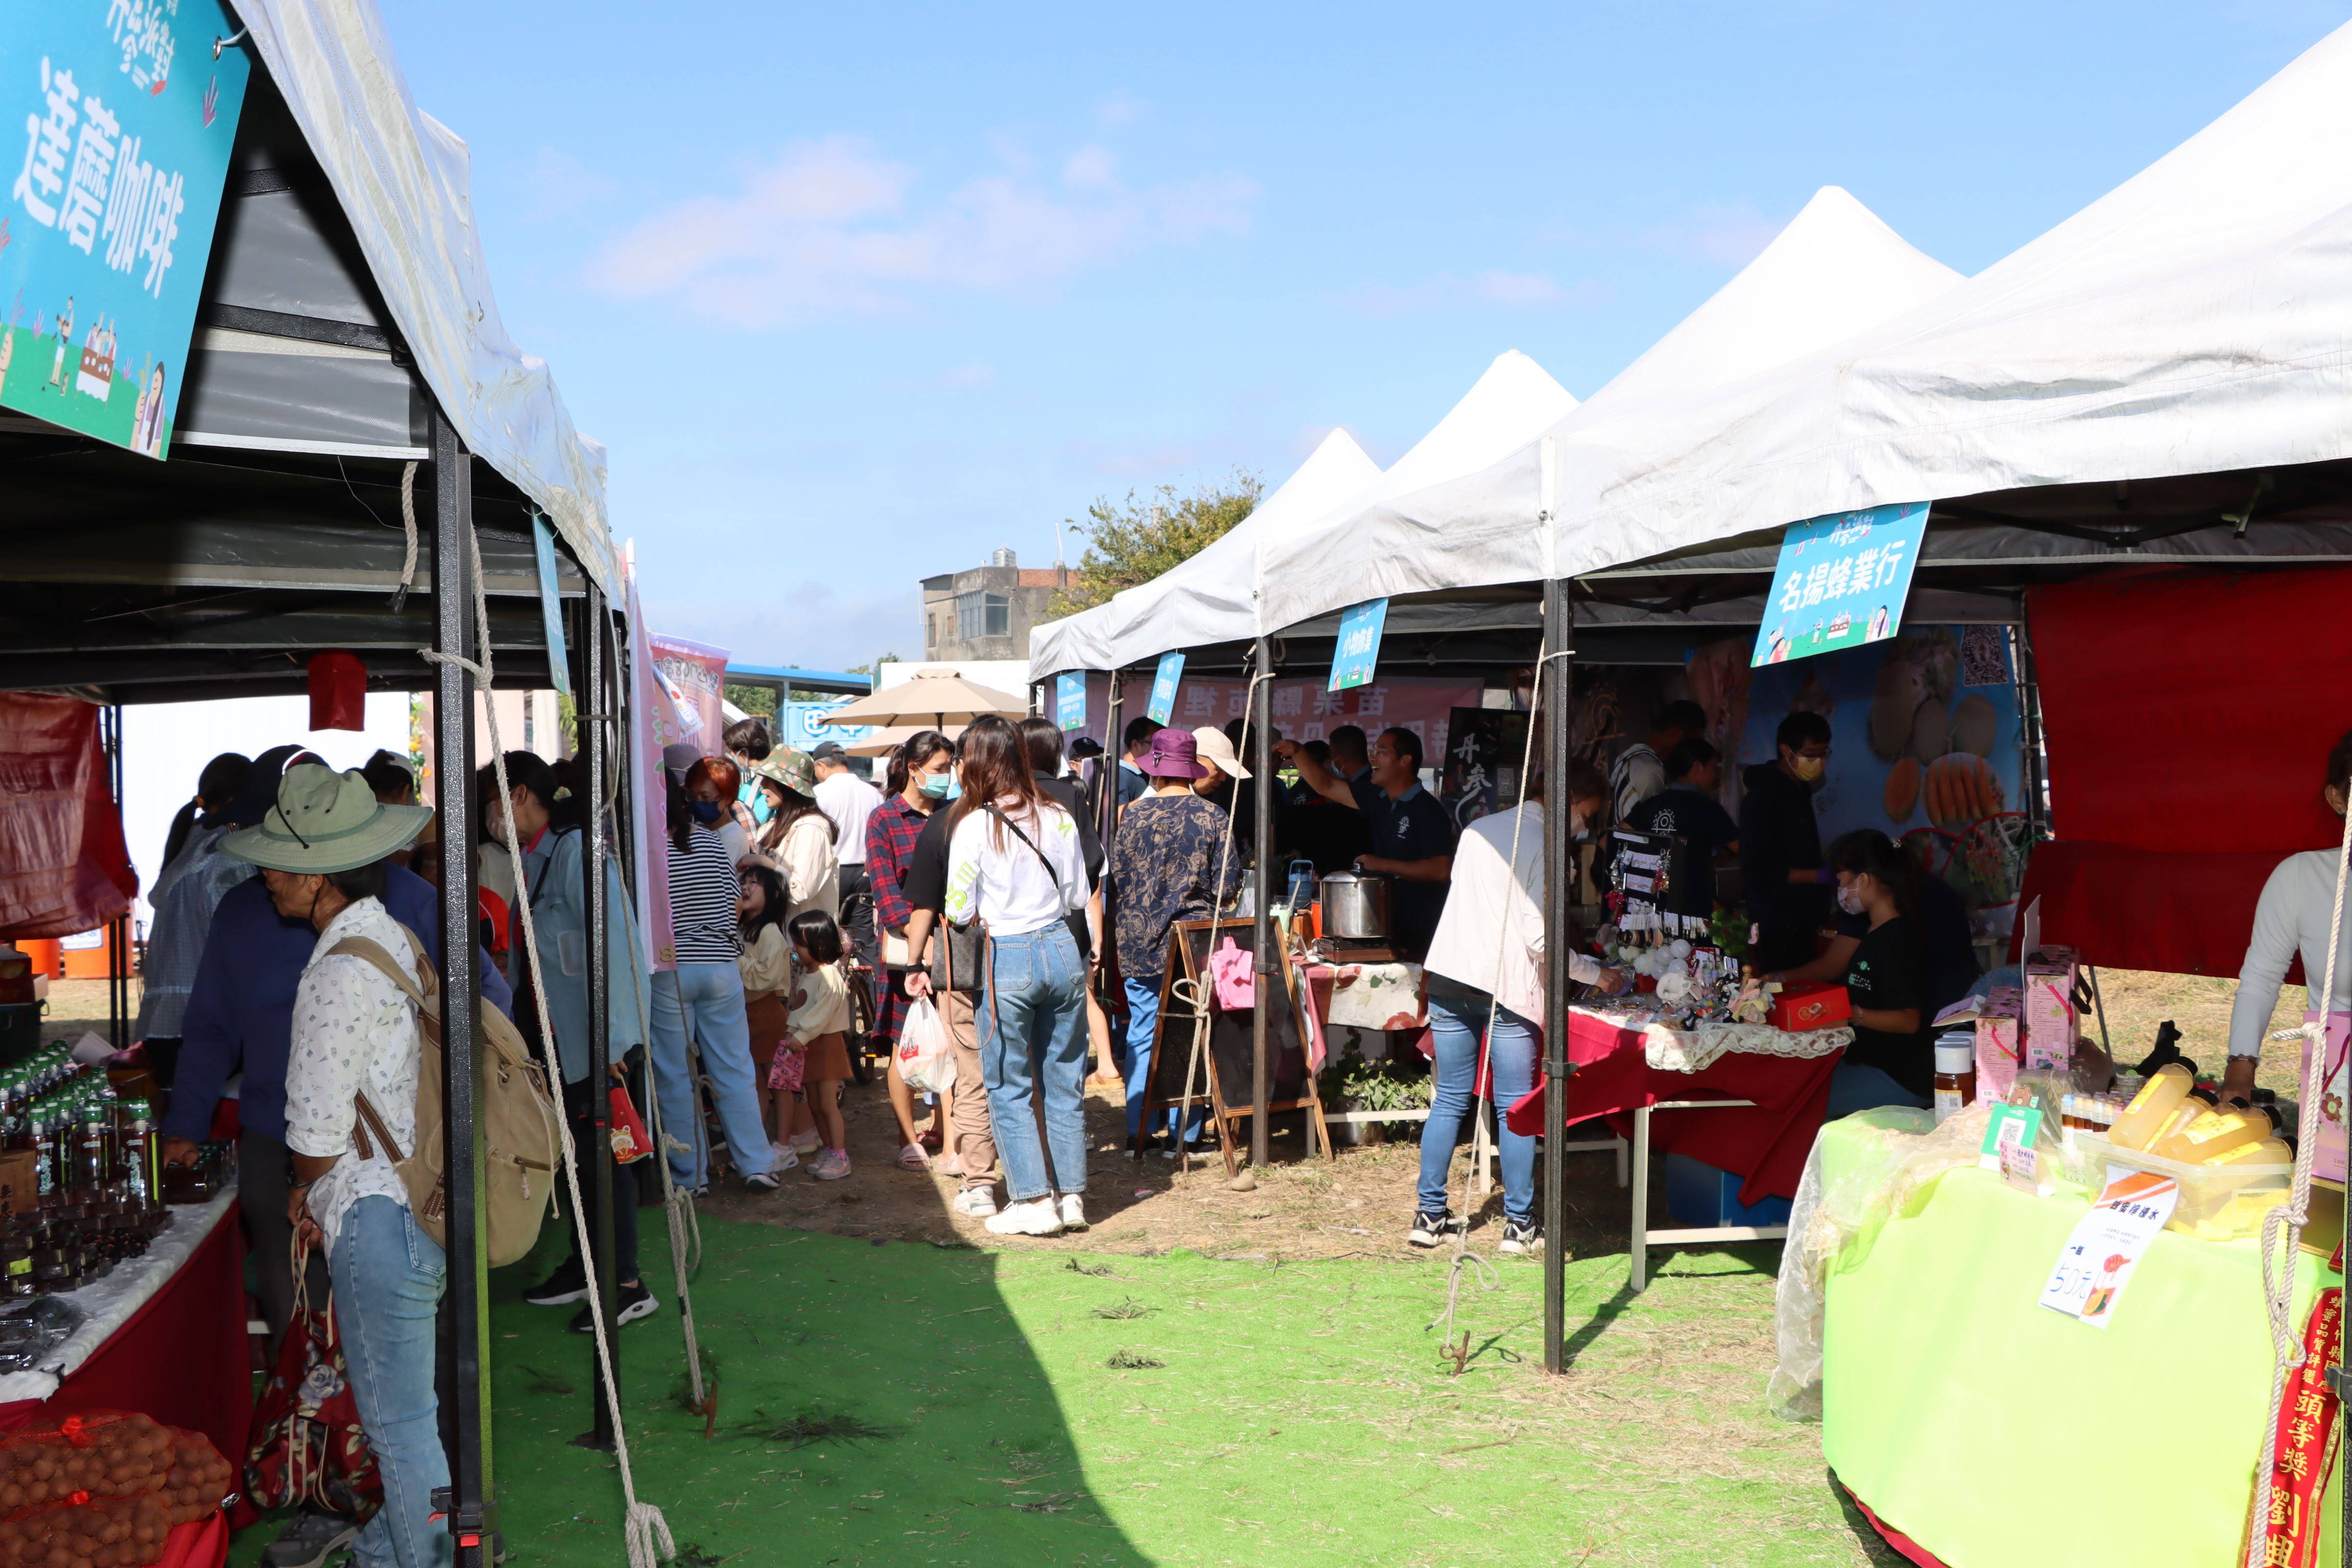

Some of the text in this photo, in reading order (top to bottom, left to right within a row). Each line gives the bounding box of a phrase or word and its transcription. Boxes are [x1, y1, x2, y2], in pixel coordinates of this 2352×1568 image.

[1779, 539, 1906, 613] 名揚蜂業行
[2332, 1079, 2349, 1092] Hon
[2302, 1296, 2342, 1385] 蜂蜜品質評鑑
[2279, 1389, 2327, 1481] 頭等獎
